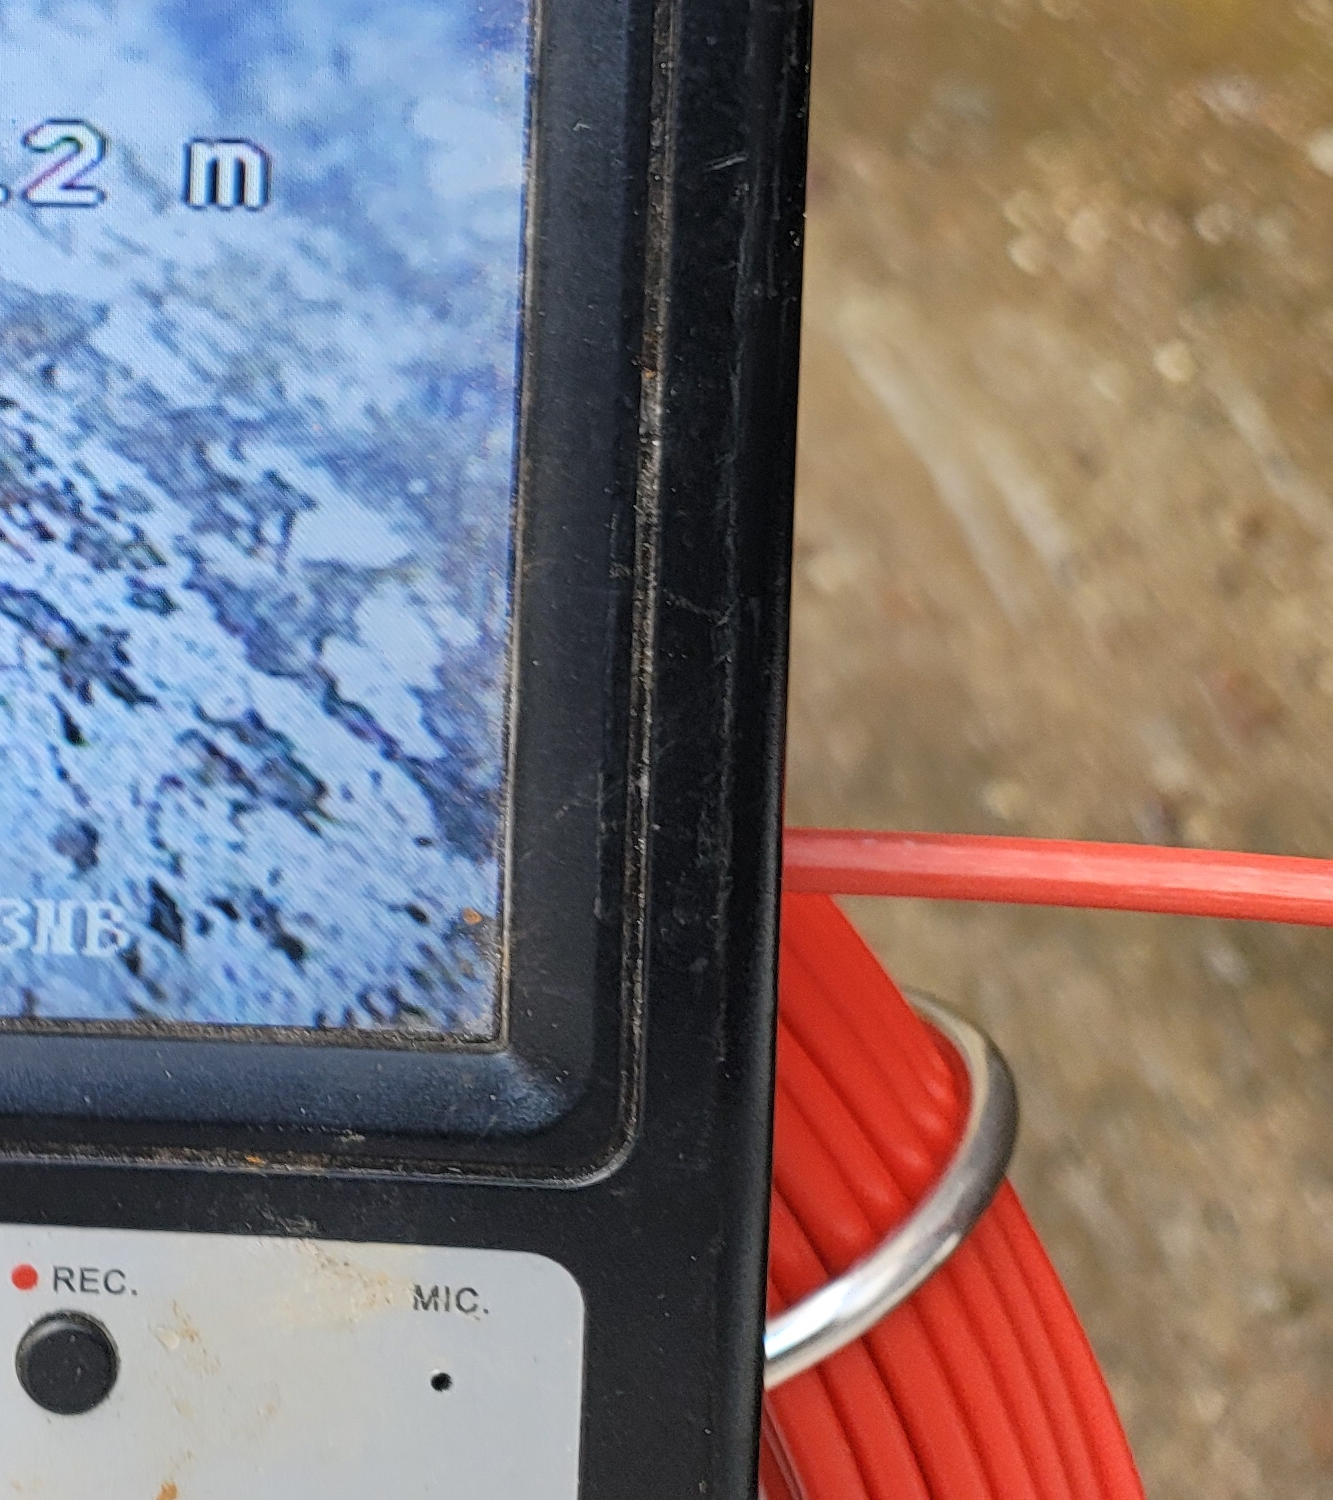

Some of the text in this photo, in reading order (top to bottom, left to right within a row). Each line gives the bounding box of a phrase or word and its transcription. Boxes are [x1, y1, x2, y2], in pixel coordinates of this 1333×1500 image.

[183, 135, 273, 211] m
[51, 1263, 140, 1297] REC.
[411, 1282, 491, 1316] MIC.
